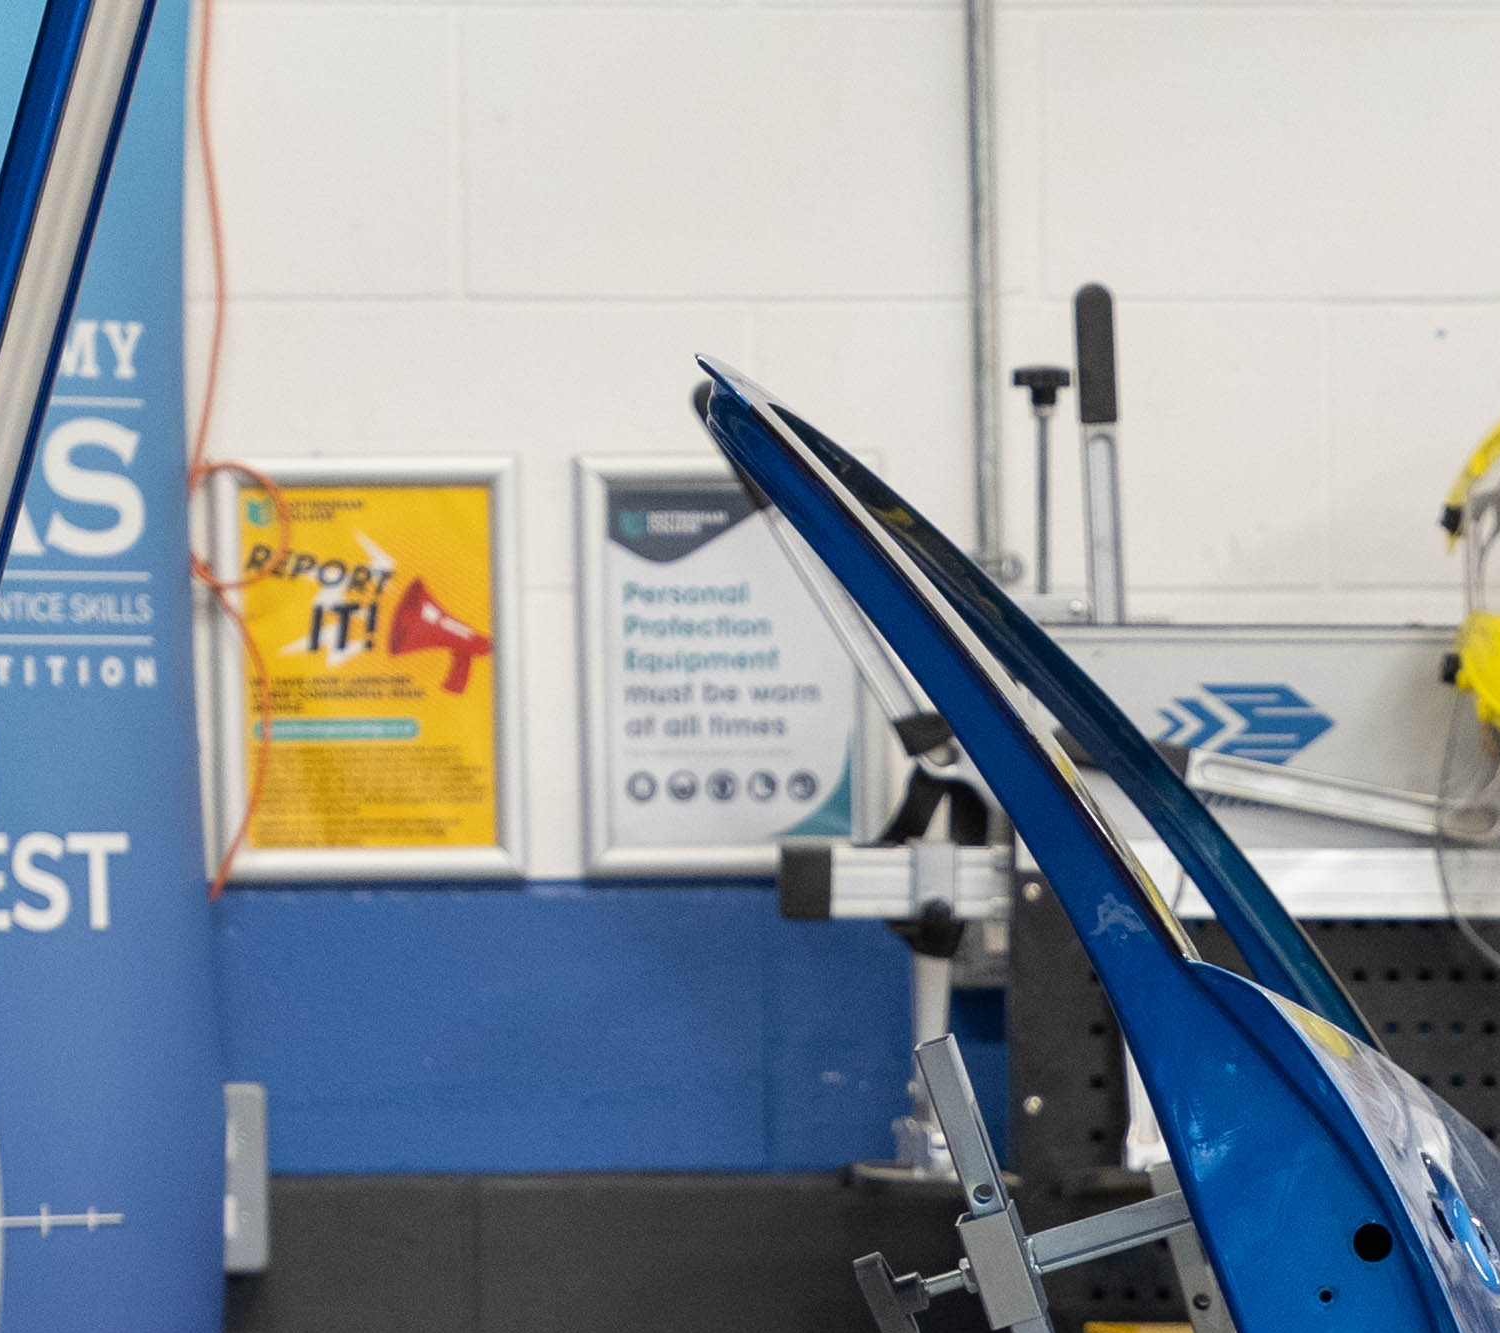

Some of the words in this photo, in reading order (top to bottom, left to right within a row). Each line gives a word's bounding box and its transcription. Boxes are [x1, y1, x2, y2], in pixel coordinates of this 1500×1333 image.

[247, 544, 395, 595] REPORT
[623, 582, 750, 605] Personal
[69, 592, 156, 625] SKILLS
[308, 602, 379, 651] IT!
[624, 615, 772, 638] Protection
[624, 648, 780, 676] Equipment
[624, 683, 693, 704] must
[702, 682, 741, 704] be
[750, 684, 823, 704] worn
[625, 715, 655, 737] at
[663, 714, 701, 737] all
[708, 714, 788, 737] times
